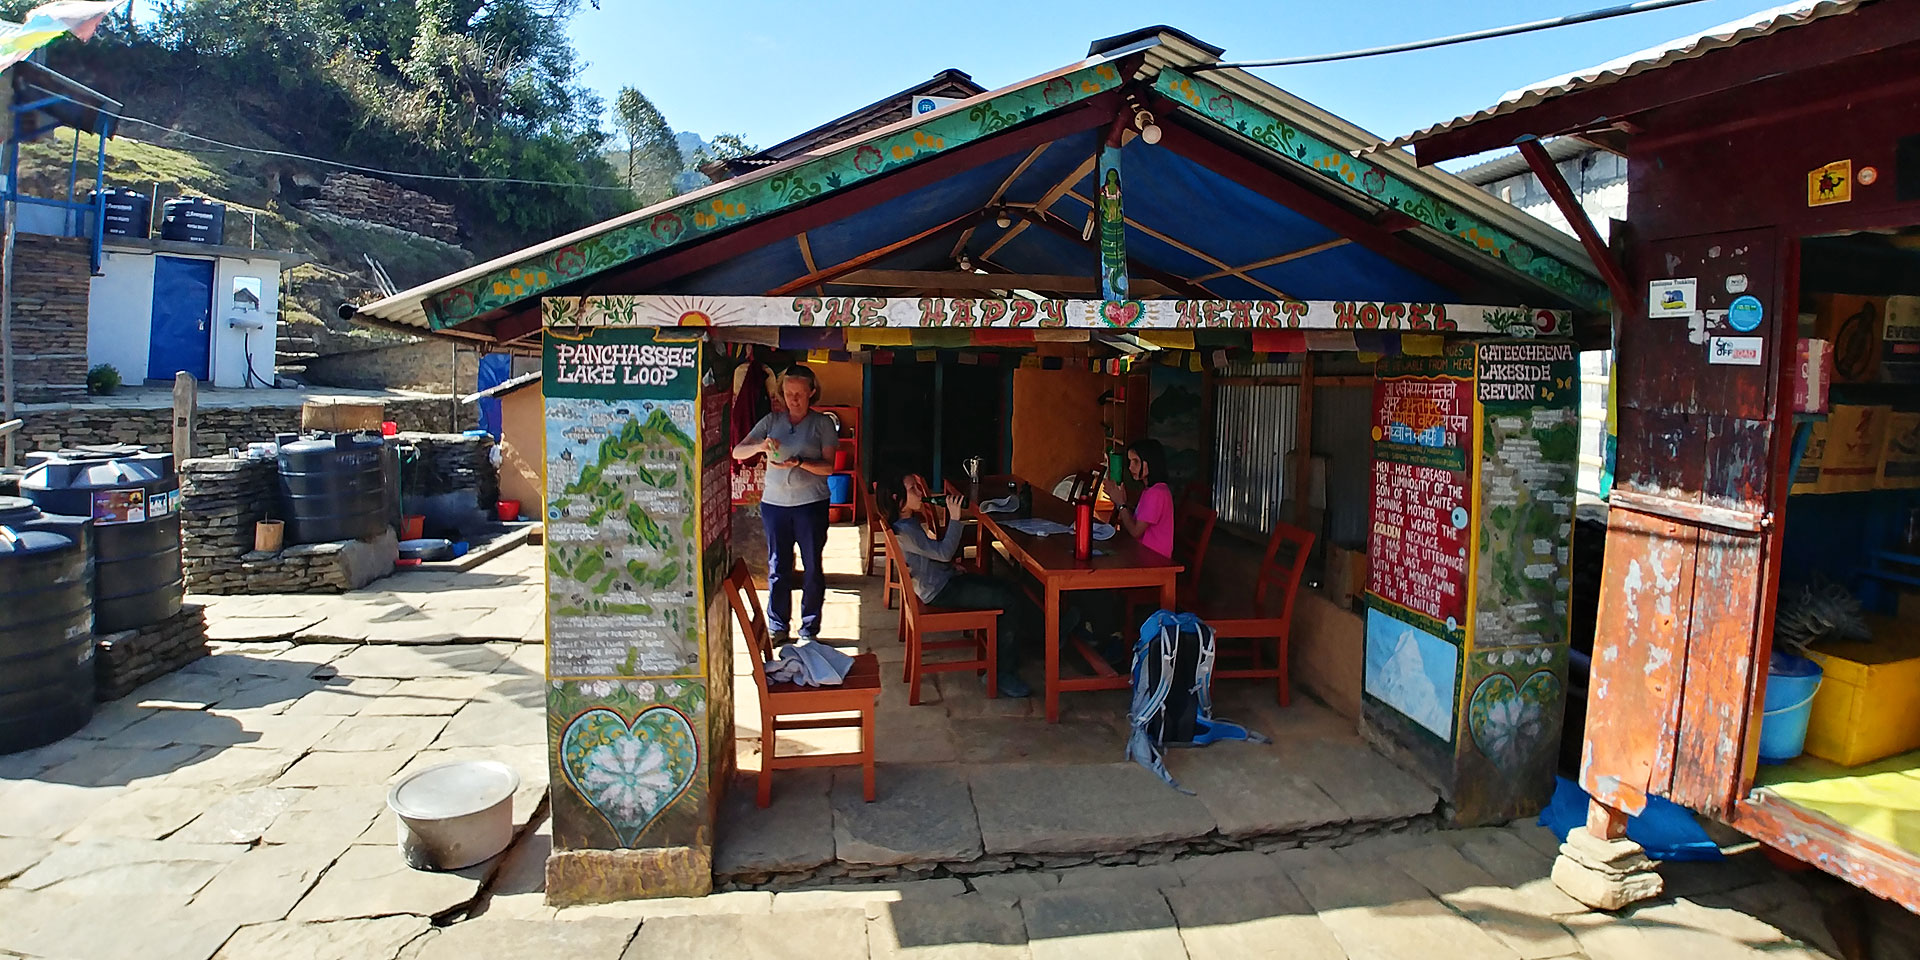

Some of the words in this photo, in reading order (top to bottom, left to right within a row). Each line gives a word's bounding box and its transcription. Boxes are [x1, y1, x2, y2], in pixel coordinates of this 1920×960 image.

[792, 298, 888, 327] THE
[918, 298, 1069, 327] HAPPY
[1174, 300, 1308, 329] HEART
[1333, 302, 1458, 331] HOTEL
[555, 344, 697, 368] PANCHASSEE
[1480, 344, 1574, 363] GATEECHEENA
[1452, 358, 1472, 371] HERE
[1480, 364, 1551, 382] LAKESIDE
[557, 365, 616, 385] LAKE
[623, 366, 679, 386] LOOP
[1479, 383, 1535, 401] RETURN
[1395, 463, 1413, 477] HAVE
[1415, 466, 1452, 483] INCREASED
[1376, 473, 1388, 485] THE
[1391, 476, 1431, 492] LUMINOSITY
[1434, 483, 1445, 495] OF
[1448, 485, 1463, 499] THE
[1376, 484, 1391, 496] SON
[1394, 488, 1403, 499] OF
[1406, 490, 1420, 503] THE
[1376, 497, 1403, 513] SHINING
[1374, 523, 1401, 539] GOLDEN
[1375, 510, 1386, 521] HIS
[1388, 513, 1405, 526] NECK
[1410, 519, 1437, 536] WEARS
[1441, 524, 1457, 541] THE
[1373, 547, 1383, 558] OF
[1385, 550, 1398, 564] THE
[1432, 564, 1448, 579] AND
[1373, 558, 1390, 574] WITH
[1406, 543, 1419, 558] THE
[1422, 549, 1464, 573] UTTERANCE
[1373, 570, 1382, 583] HE
[1385, 574, 1392, 586] IS
[1396, 577, 1409, 592] THE
[1413, 584, 1441, 603] SEEKER
[1373, 582, 1381, 593] OF
[1385, 586, 1398, 600] THE
[1402, 592, 1441, 618] PLENITUDE
